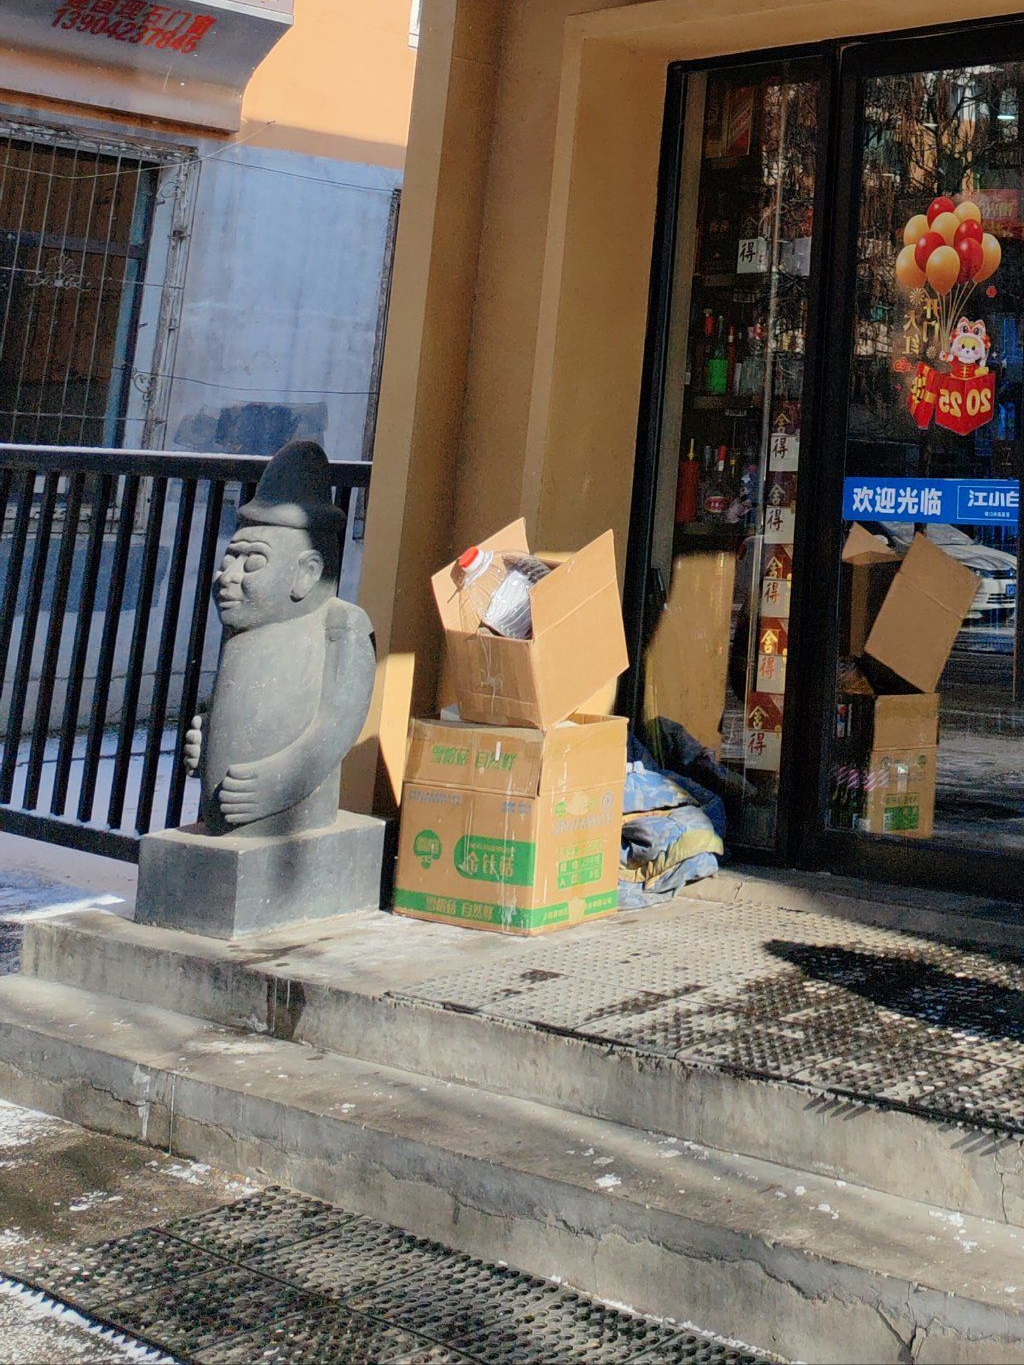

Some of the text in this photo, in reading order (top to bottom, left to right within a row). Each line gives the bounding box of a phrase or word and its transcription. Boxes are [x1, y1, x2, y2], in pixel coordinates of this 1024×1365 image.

[852, 487, 942, 516] 欢迎光临
[968, 490, 1020, 508] 江小白
